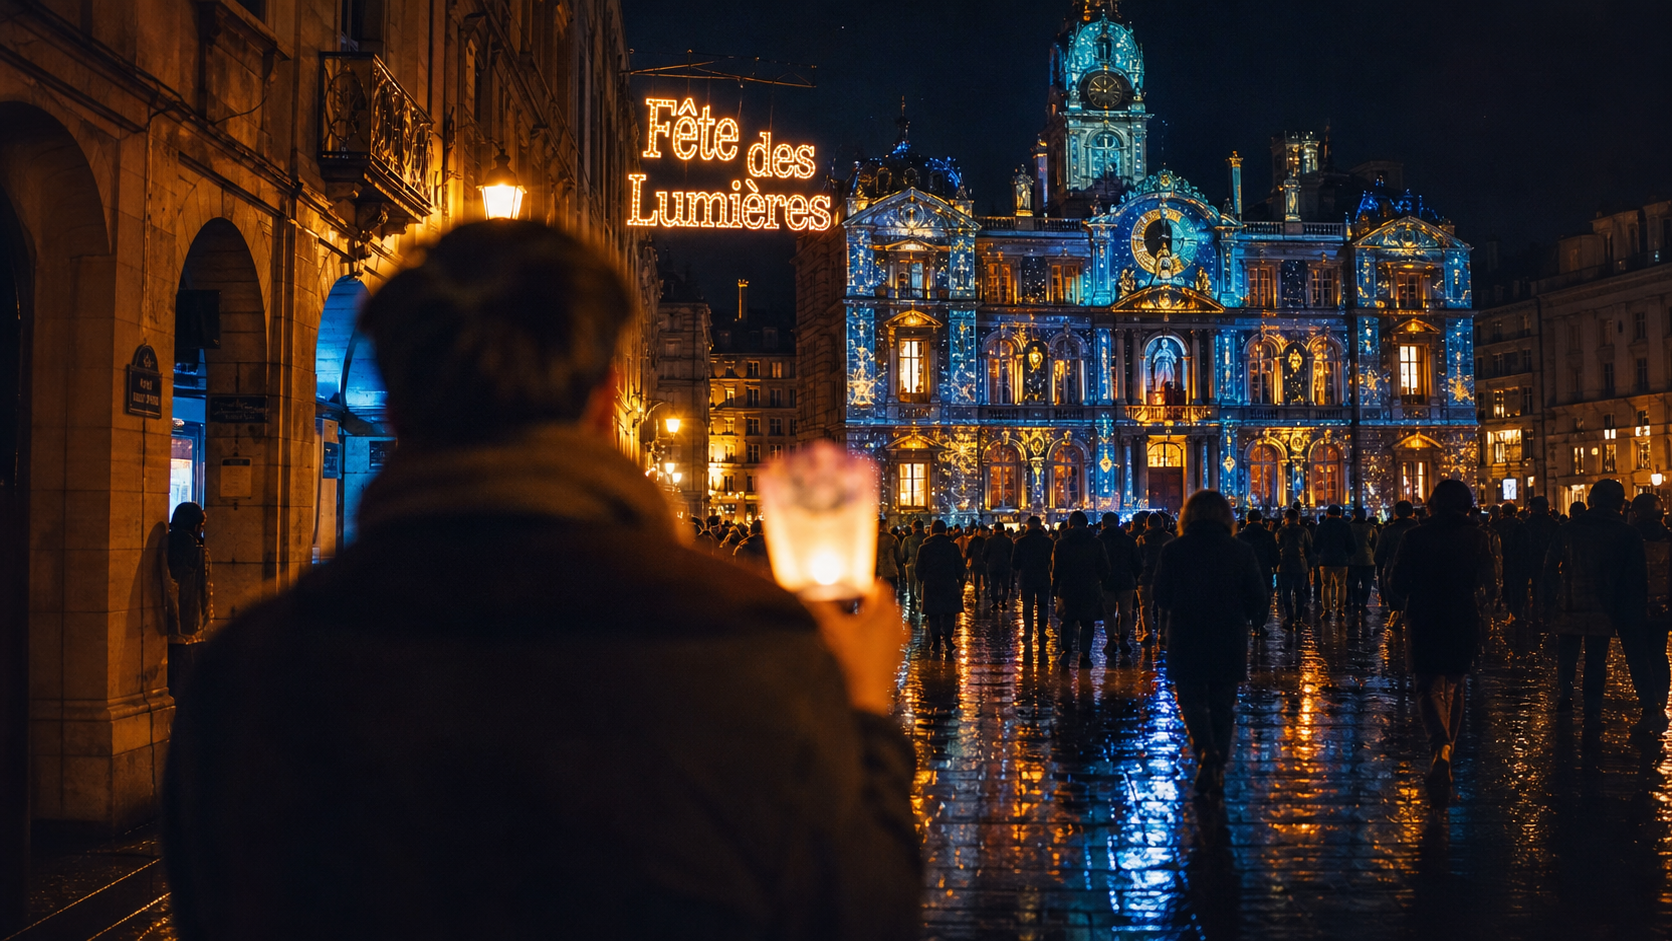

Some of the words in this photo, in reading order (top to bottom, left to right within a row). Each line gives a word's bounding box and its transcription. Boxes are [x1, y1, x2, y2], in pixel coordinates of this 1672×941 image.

[642, 97, 740, 161] Fête
[747, 131, 816, 179] des
[626, 173, 832, 231] Lumières
